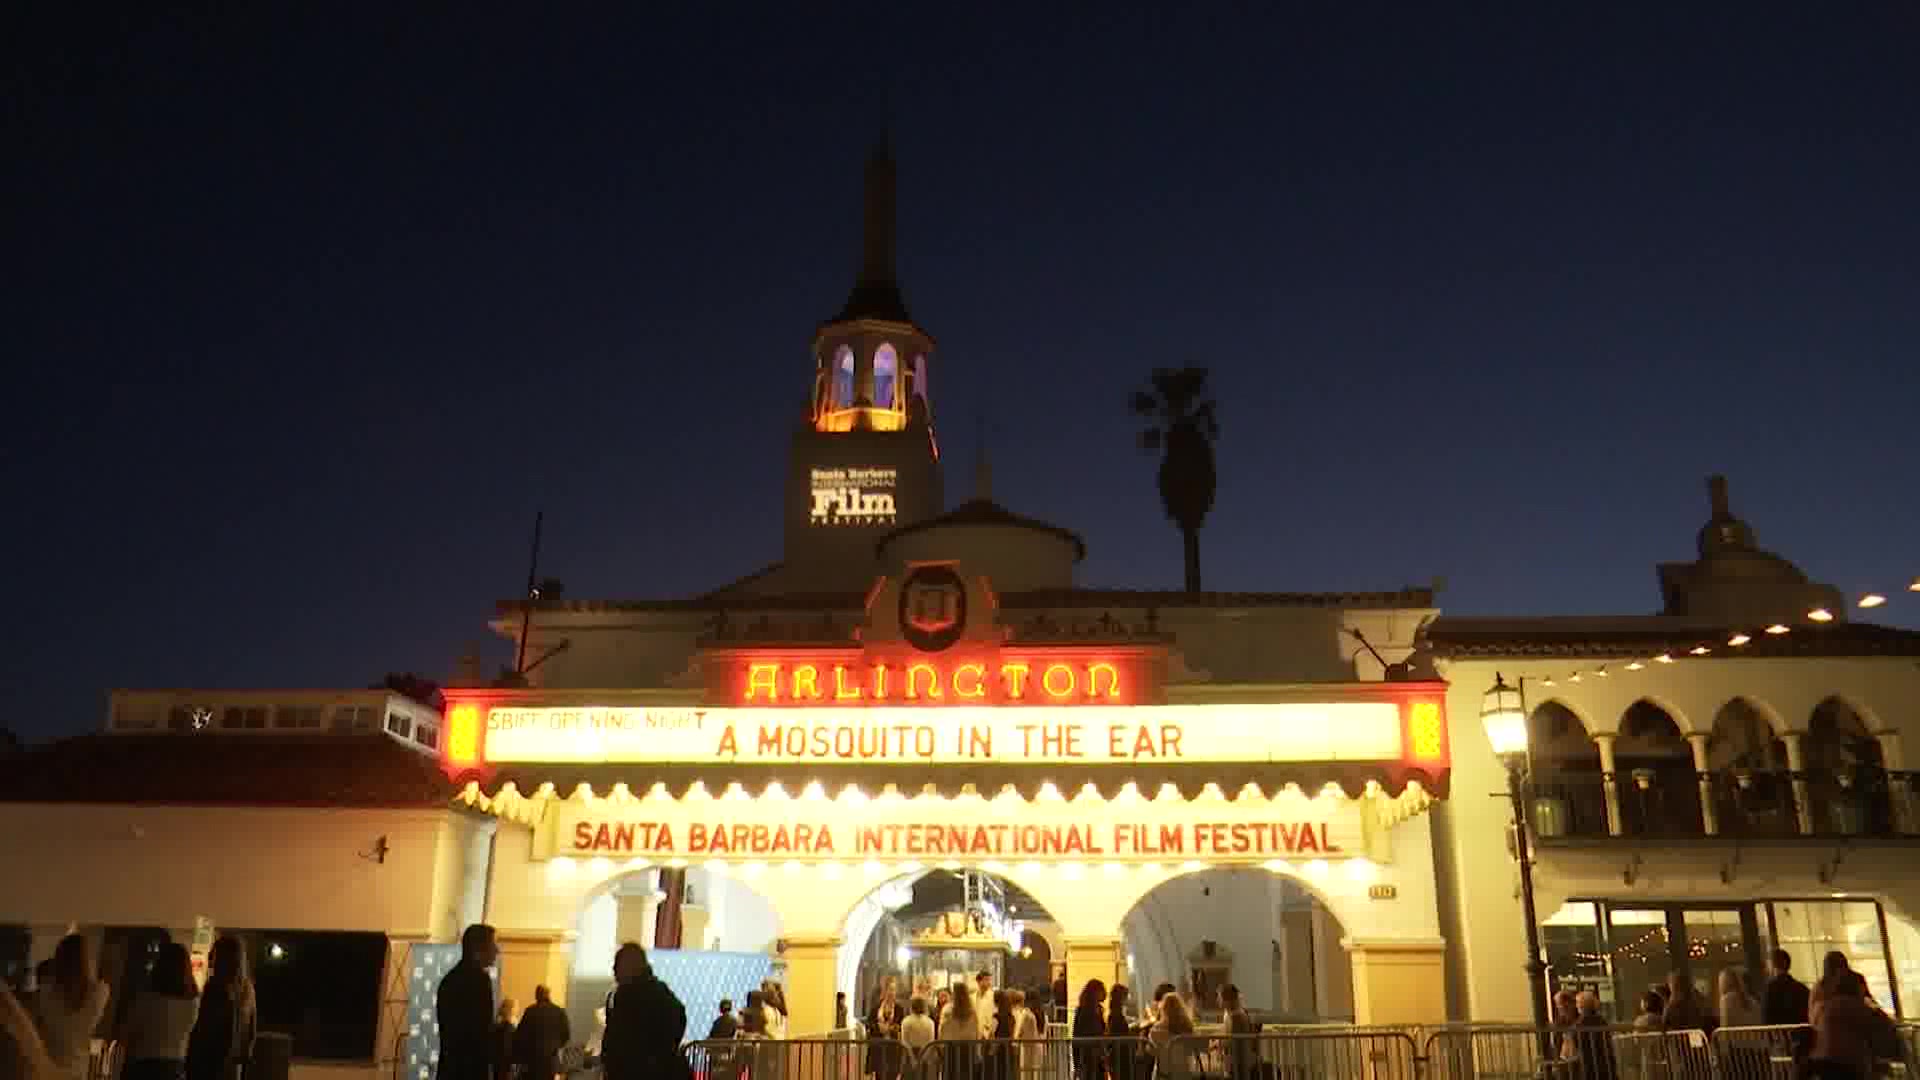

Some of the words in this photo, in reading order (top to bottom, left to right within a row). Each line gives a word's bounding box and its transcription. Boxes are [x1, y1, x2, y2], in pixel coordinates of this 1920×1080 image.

[811, 488, 897, 516] Film
[744, 663, 1122, 701] ARLINGTON
[715, 726, 739, 757] A
[757, 726, 934, 757] MOSQUITO
[957, 726, 992, 757] IN
[1021, 725, 1083, 757] THE
[1109, 725, 1183, 757] EAR
[574, 823, 674, 852] SANTA
[688, 823, 834, 852] BARBARA
[855, 824, 1104, 853] INTERNATIONAL
[1114, 824, 1184, 854] FILM
[1194, 823, 1342, 854] FESTIVAL
